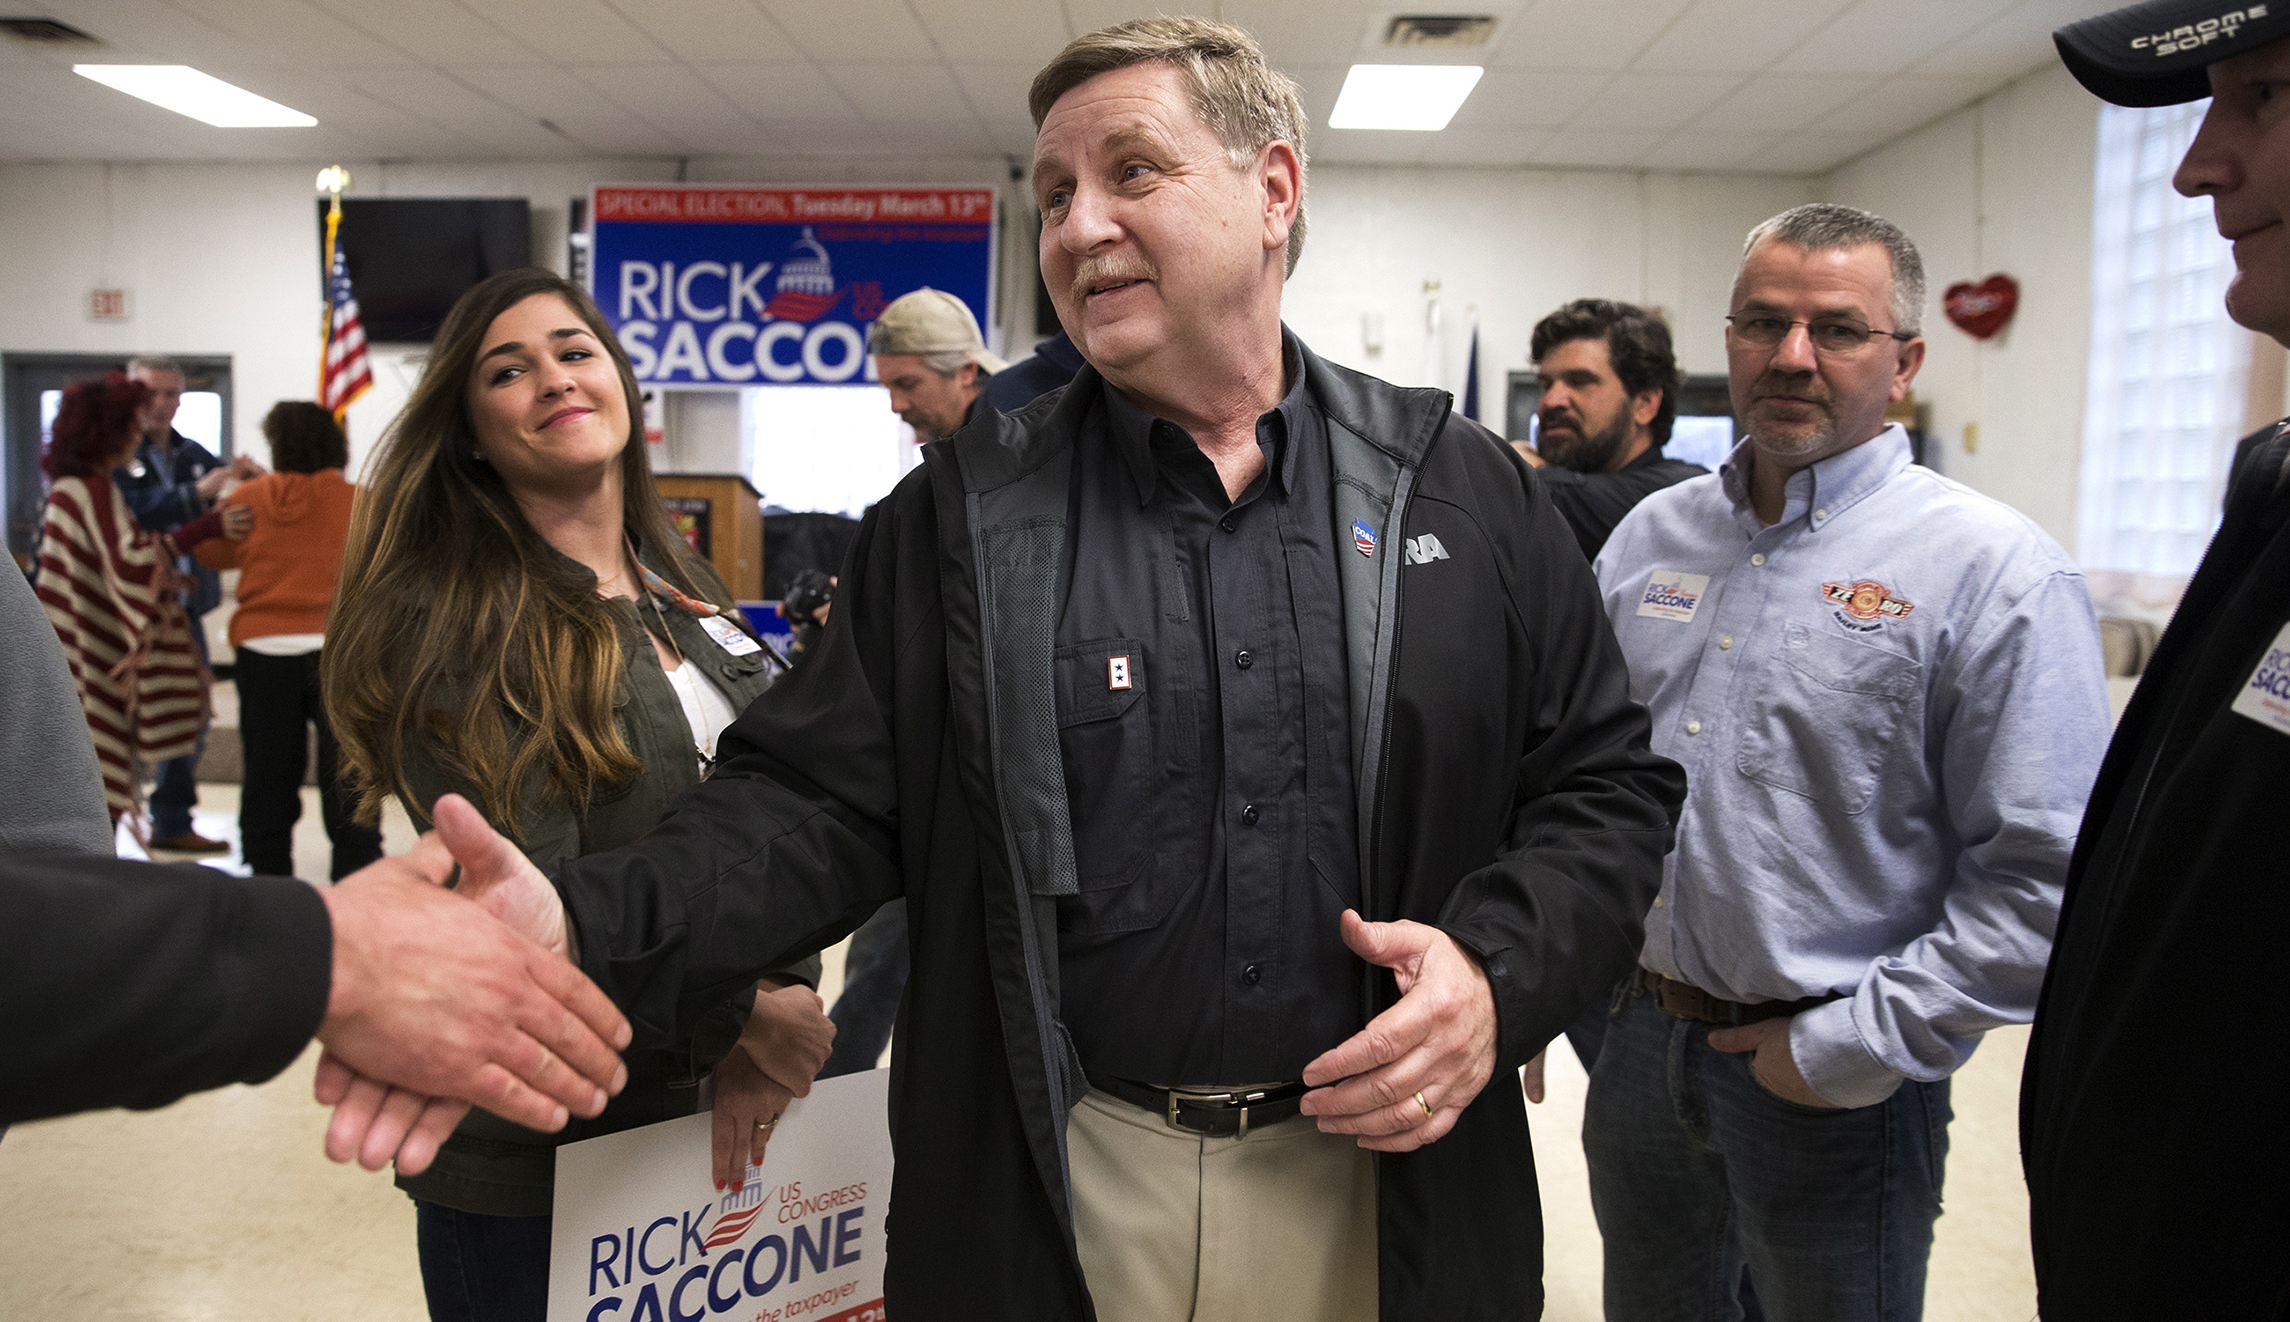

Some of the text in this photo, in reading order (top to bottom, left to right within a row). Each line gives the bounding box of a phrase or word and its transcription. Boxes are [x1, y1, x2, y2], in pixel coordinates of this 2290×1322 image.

[2131, 4, 2268, 49] CHROME
[2156, 24, 2241, 57] SOFT
[599, 192, 680, 216] SPECIAL
[793, 192, 876, 221] Tuesday
[879, 193, 944, 217] March
[619, 260, 774, 322] RICK
[617, 319, 878, 383] SACCO
[1643, 593, 1696, 609] SACCONE
[777, 1182, 867, 1224] CONGRESS
[779, 1181, 802, 1204] US
[588, 1202, 713, 1297] RICK
[785, 1280, 860, 1319] taxpayer
